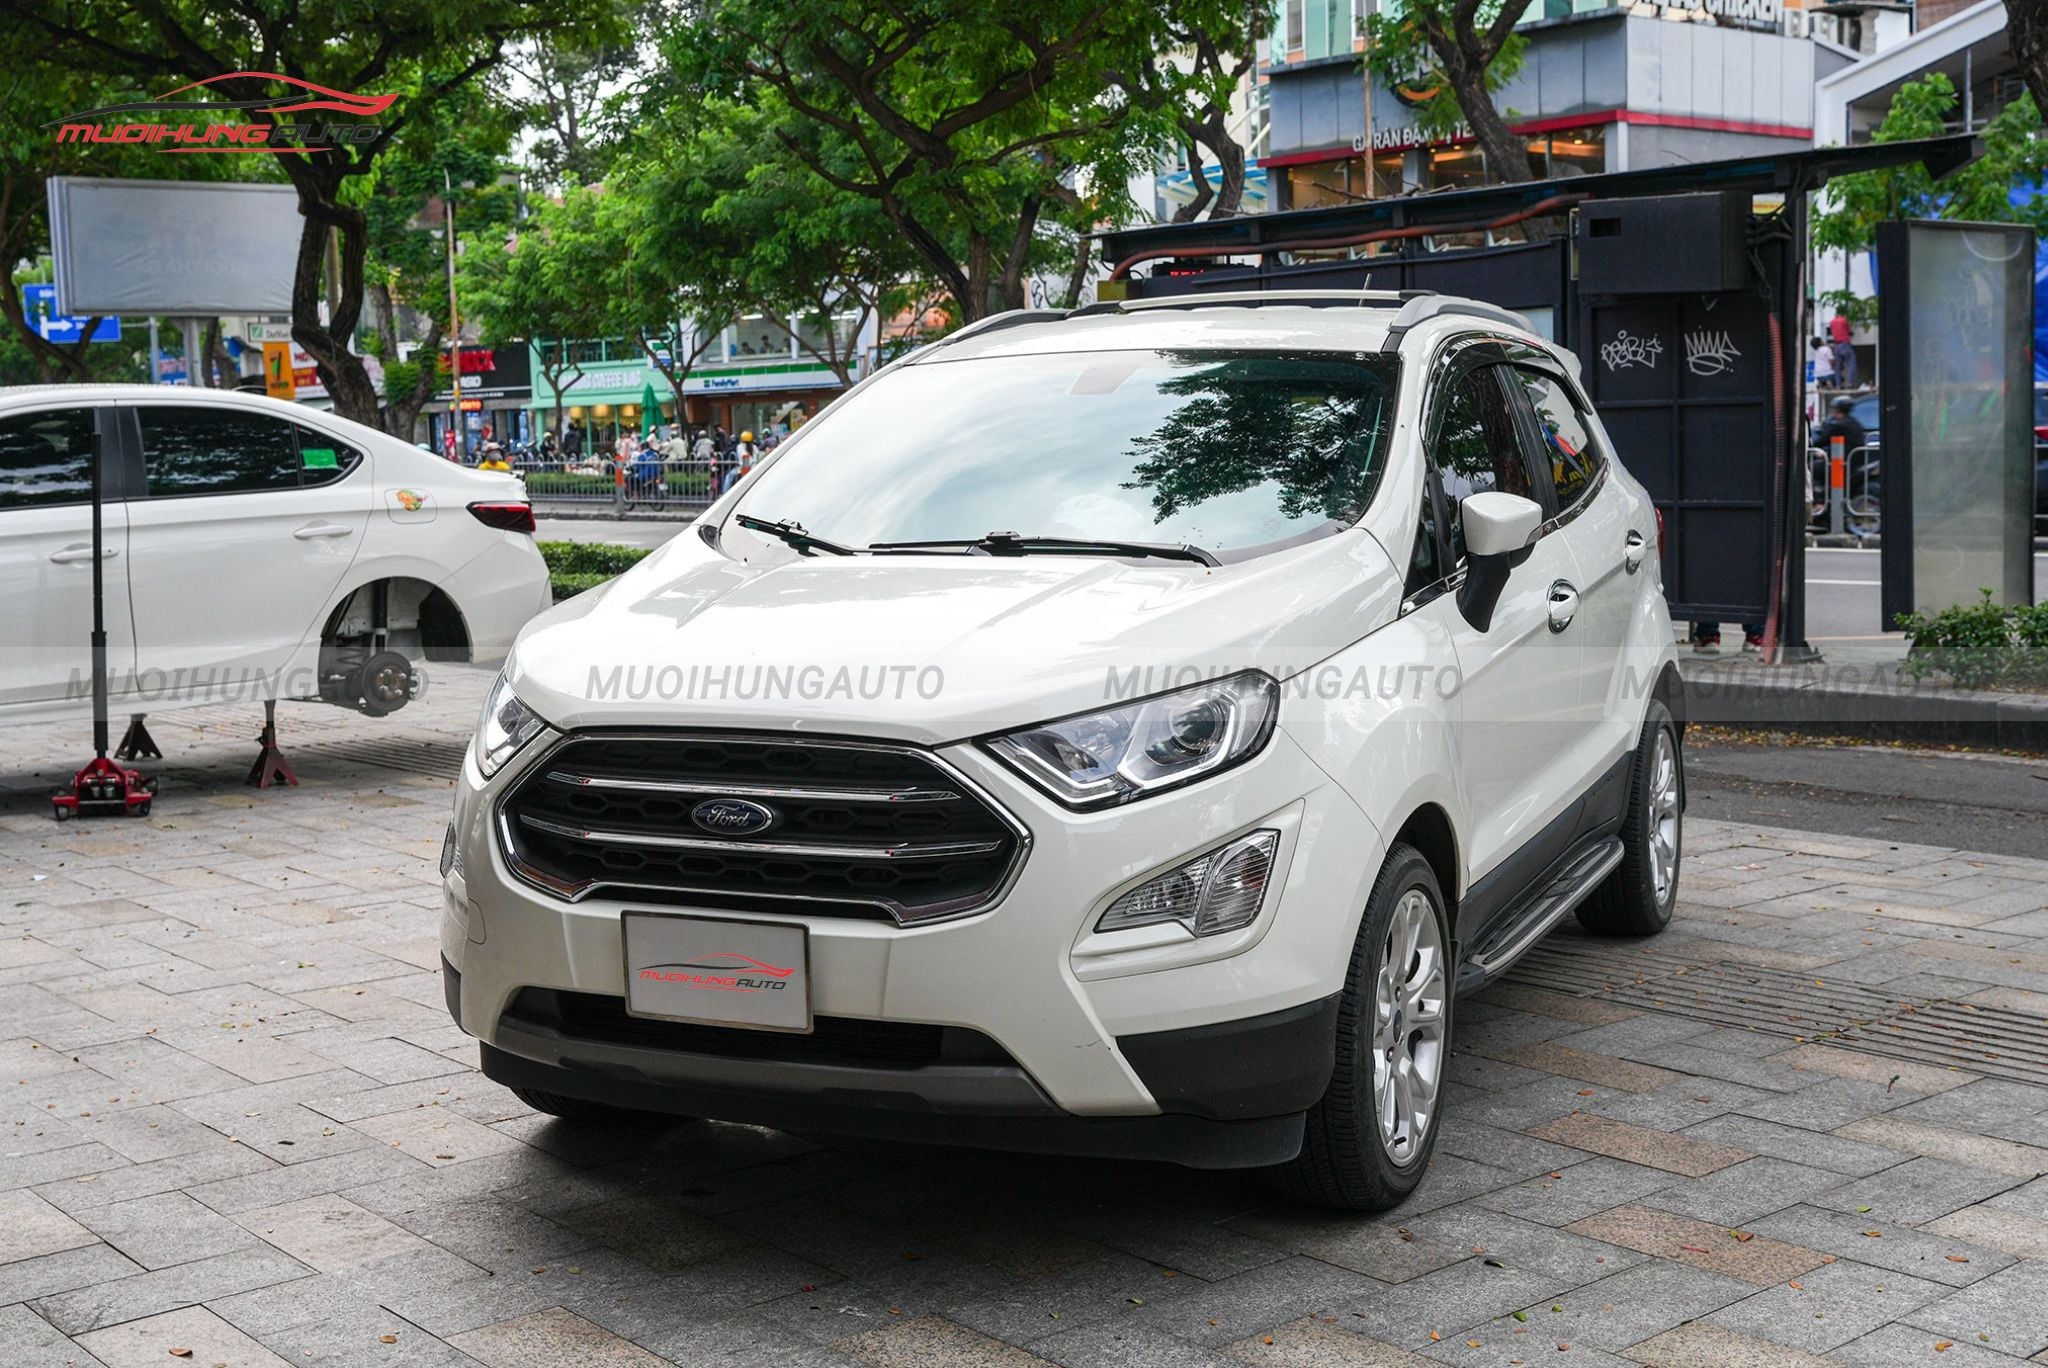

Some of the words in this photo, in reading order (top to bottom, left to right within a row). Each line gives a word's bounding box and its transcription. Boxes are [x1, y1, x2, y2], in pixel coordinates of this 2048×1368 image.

[1373, 127, 1401, 150] RÁN
[711, 378, 739, 387] FamilyMart
[707, 804, 750, 827] Ford
